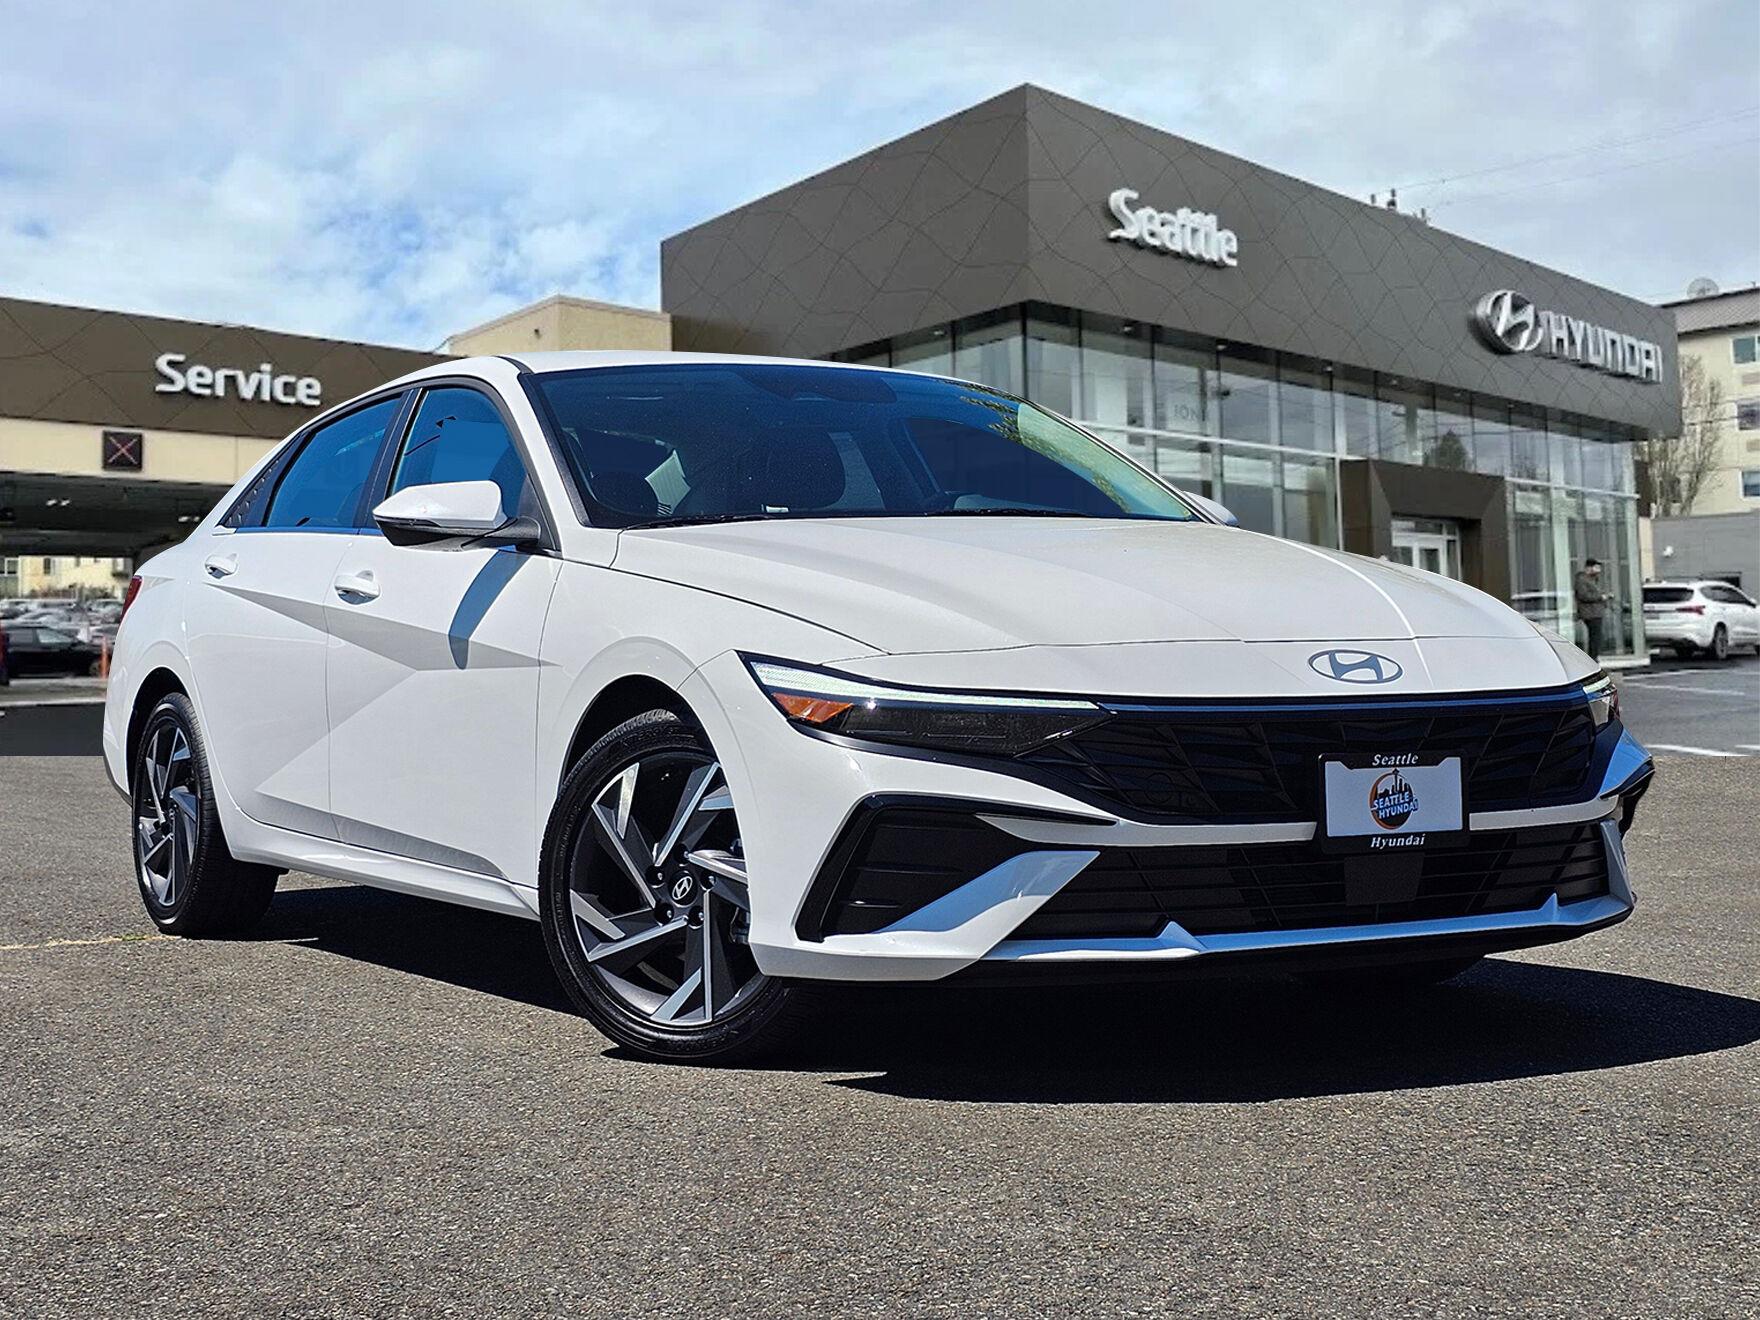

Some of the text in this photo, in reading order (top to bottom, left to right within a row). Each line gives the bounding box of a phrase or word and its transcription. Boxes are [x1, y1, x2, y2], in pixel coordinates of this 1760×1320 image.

[1108, 187, 1238, 267] Seattle
[1541, 311, 1663, 383] HYUNDAI
[155, 352, 321, 406] Service
[1372, 753, 1419, 766] Seattle
[1373, 791, 1410, 809] SEATTLE
[1379, 799, 1419, 819] HYUNDAI
[1370, 833, 1427, 850] Hyundai
